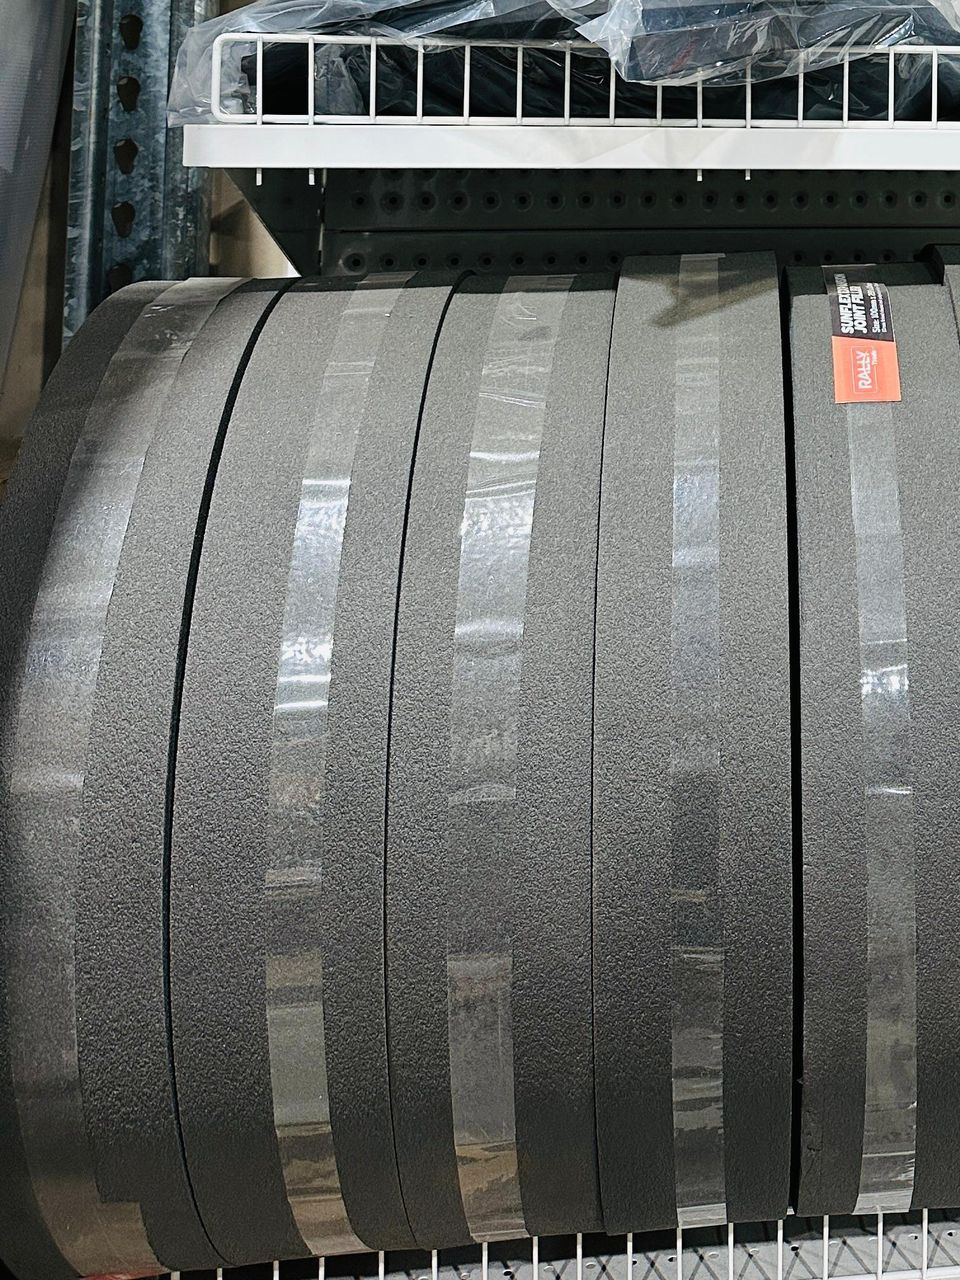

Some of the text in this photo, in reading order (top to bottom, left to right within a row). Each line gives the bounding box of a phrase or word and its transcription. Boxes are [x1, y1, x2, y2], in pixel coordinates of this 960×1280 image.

[839, 293, 855, 334] SUNFLEX
[853, 304, 868, 334] JOINT
[856, 351, 872, 389] RALLY
